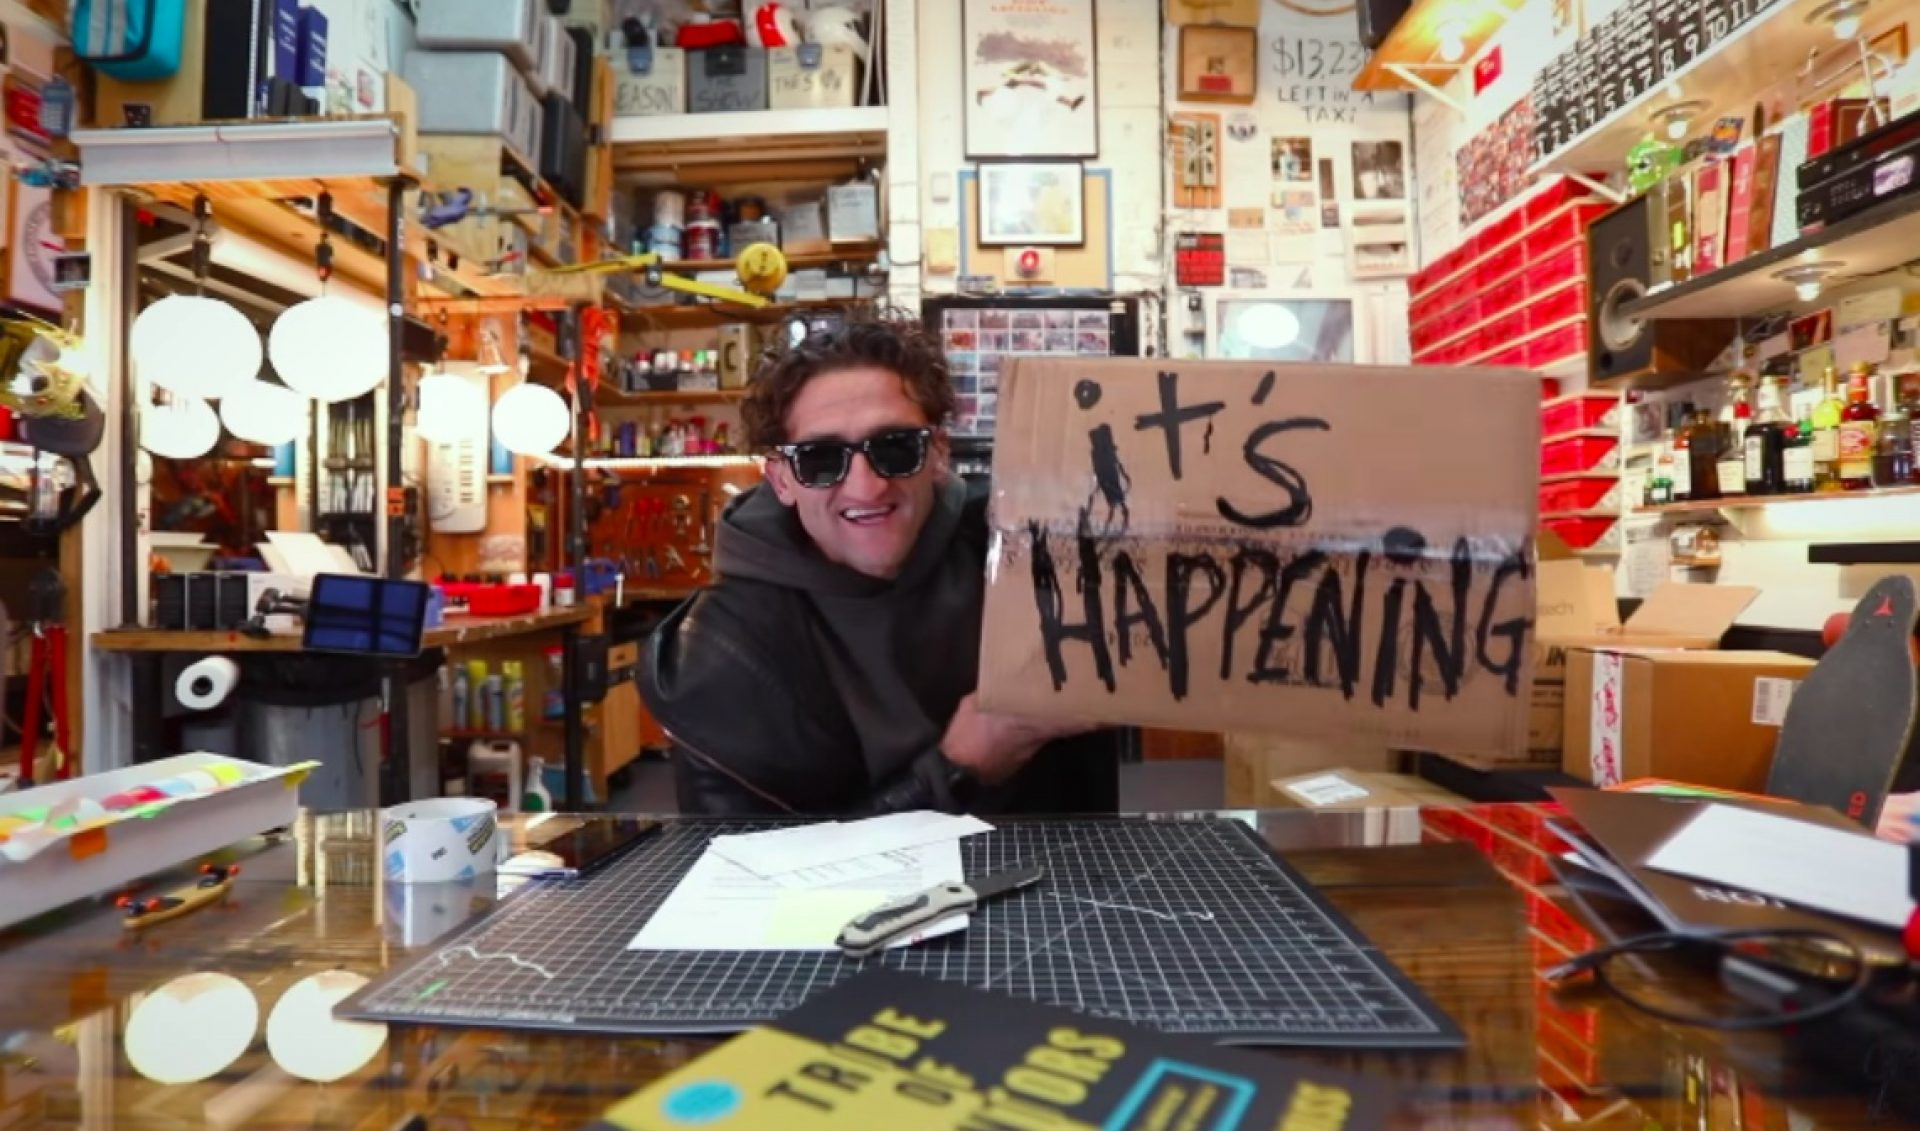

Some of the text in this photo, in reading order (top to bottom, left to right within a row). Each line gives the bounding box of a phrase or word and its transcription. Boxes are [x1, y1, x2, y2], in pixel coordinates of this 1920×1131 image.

[1623, 78, 1635, 102] 6
[1684, 33, 1699, 61] 9
[1706, 16, 1727, 44] 10
[1278, 85, 1326, 103] LEFT
[763, 1007, 946, 1112] TRIBE
[895, 1057, 975, 1106] OF
